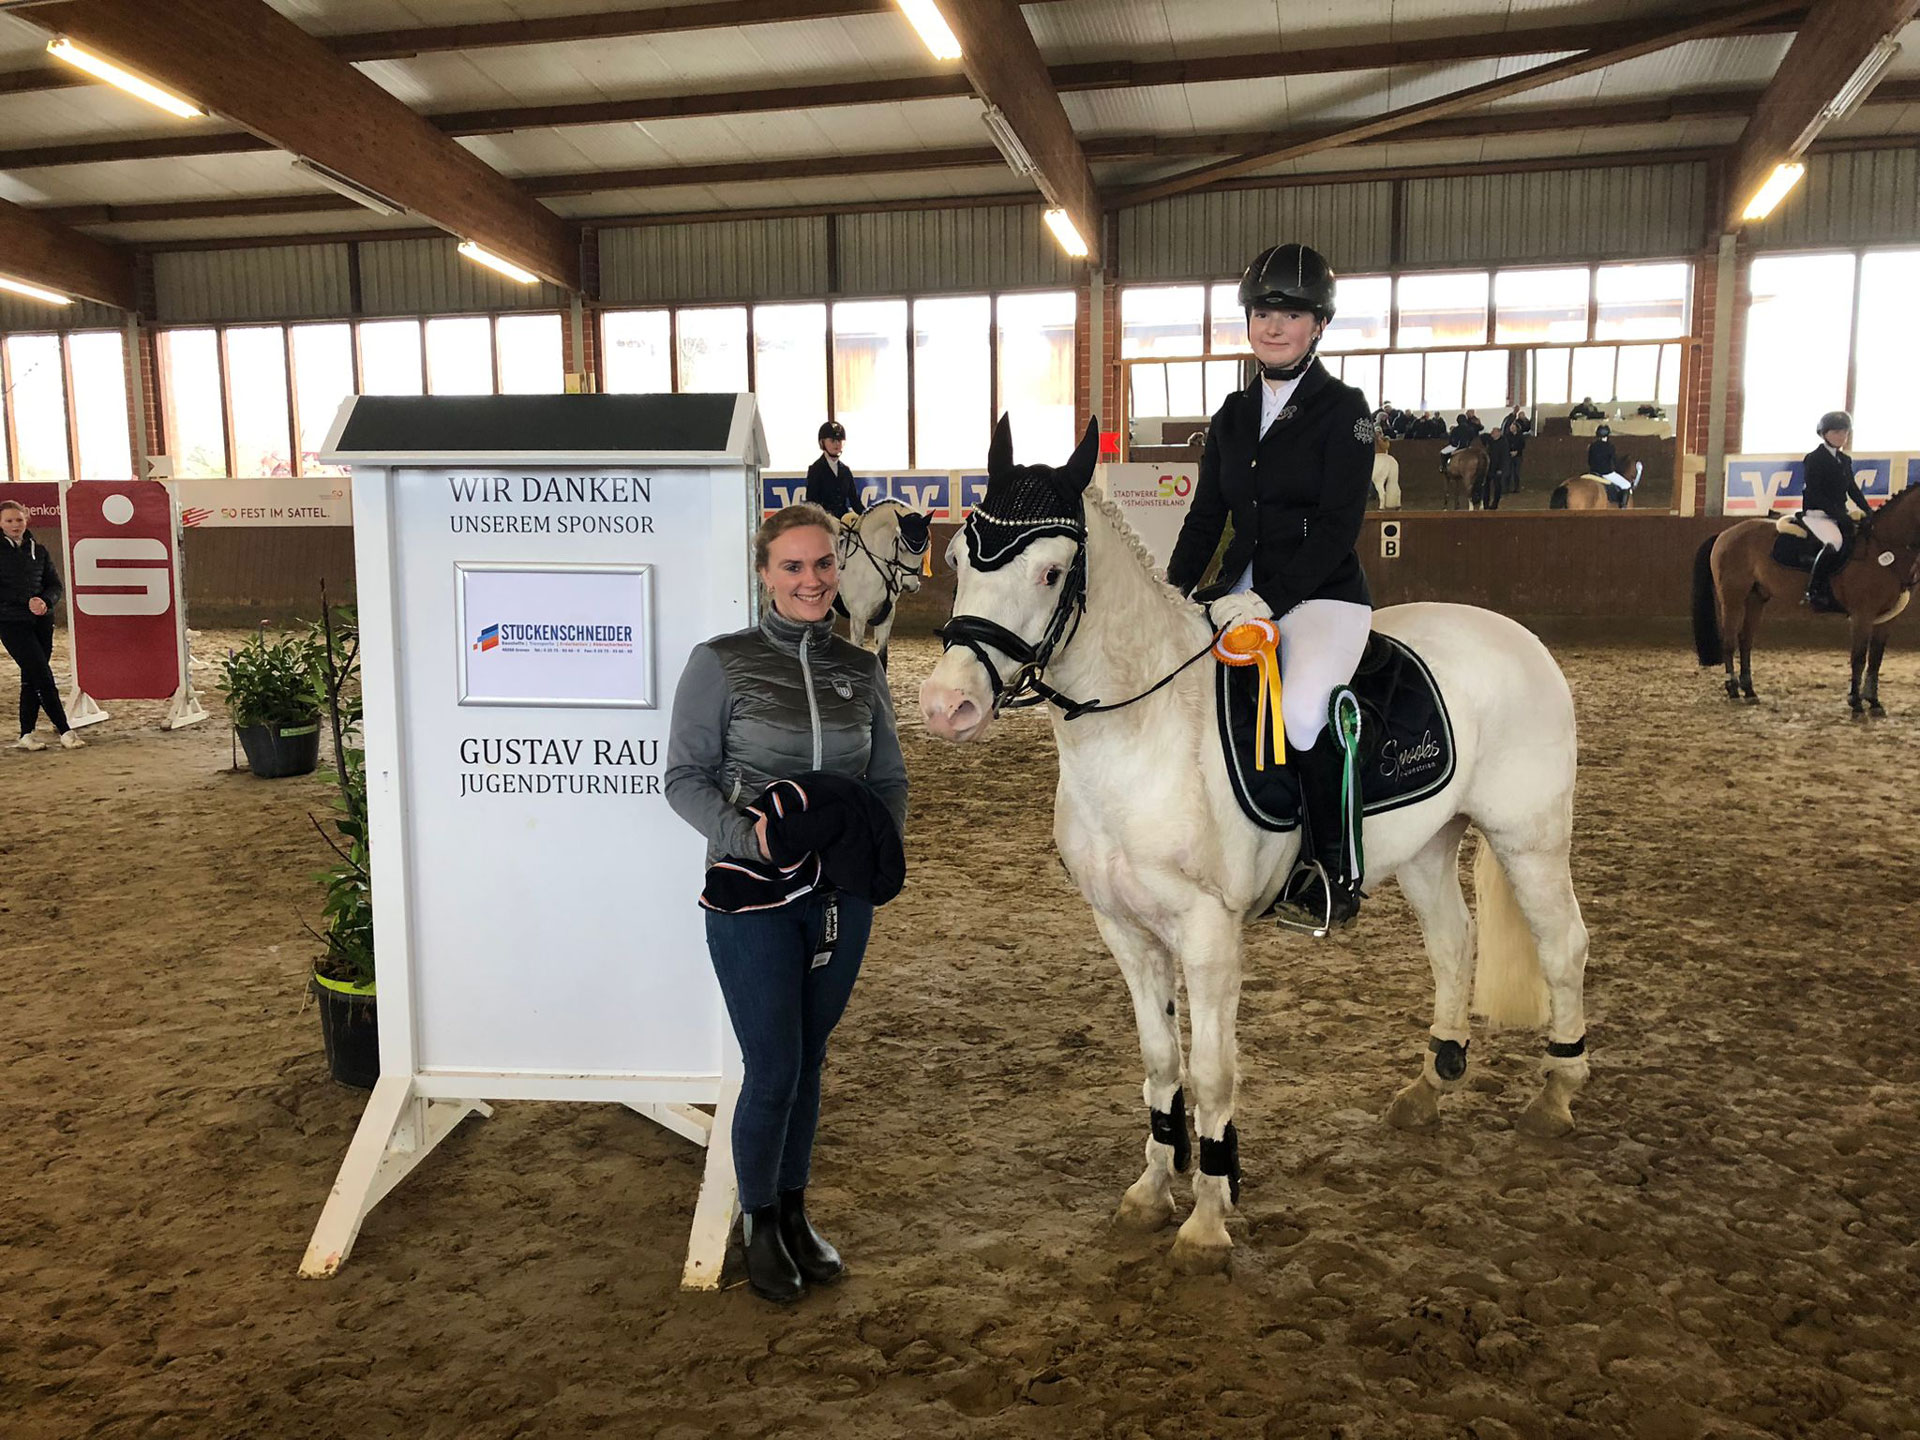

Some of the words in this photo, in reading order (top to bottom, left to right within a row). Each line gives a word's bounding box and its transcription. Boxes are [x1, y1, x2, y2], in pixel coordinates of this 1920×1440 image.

[448, 477, 513, 503] WIR
[522, 477, 652, 503] DANKEN
[1113, 490, 1158, 498] STADTWERKE
[240, 507, 267, 519] FEST
[270, 507, 283, 518] IM
[287, 507, 331, 518] SATTEL.
[450, 515, 551, 534] UNSEREM
[557, 515, 655, 534] SPONSOR
[1385, 541, 1396, 556] B
[460, 738, 584, 765] GUSTAV
[593, 739, 659, 766] RAU
[1380, 729, 1440, 782] Spooks
[460, 773, 662, 798] JUGENDTURNIER
